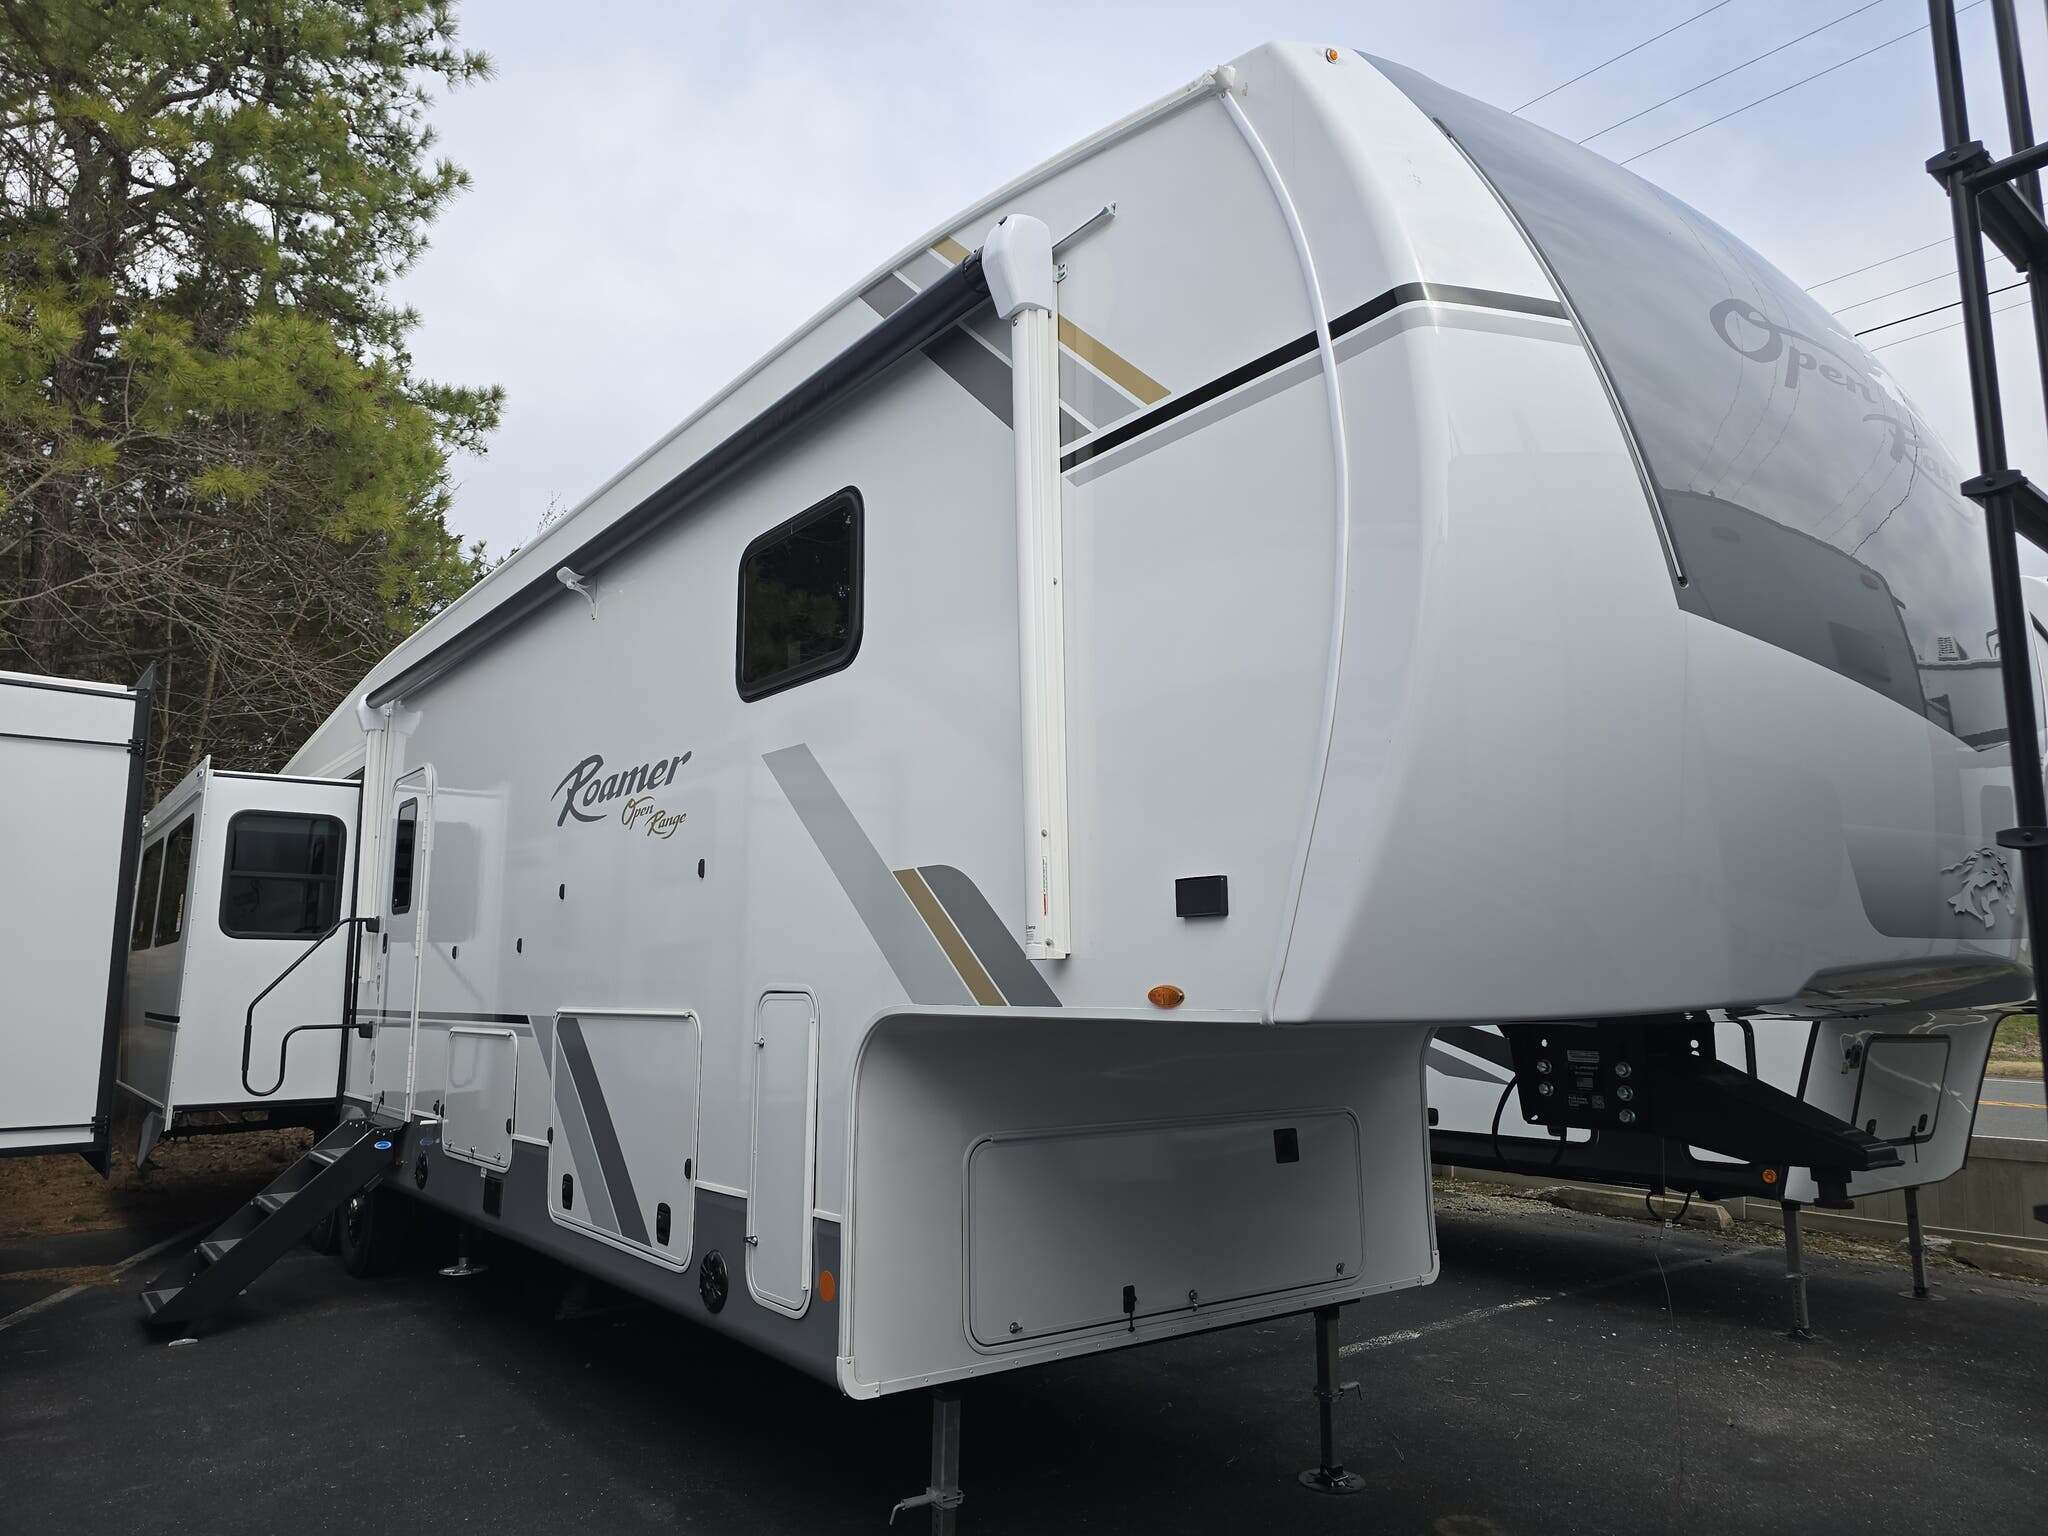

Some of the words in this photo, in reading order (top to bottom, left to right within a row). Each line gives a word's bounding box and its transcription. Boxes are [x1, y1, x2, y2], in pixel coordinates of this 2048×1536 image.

[1710, 298, 1877, 404] Open
[551, 751, 692, 827] Roamer
[621, 796, 656, 830] Open
[645, 810, 687, 840] Range
